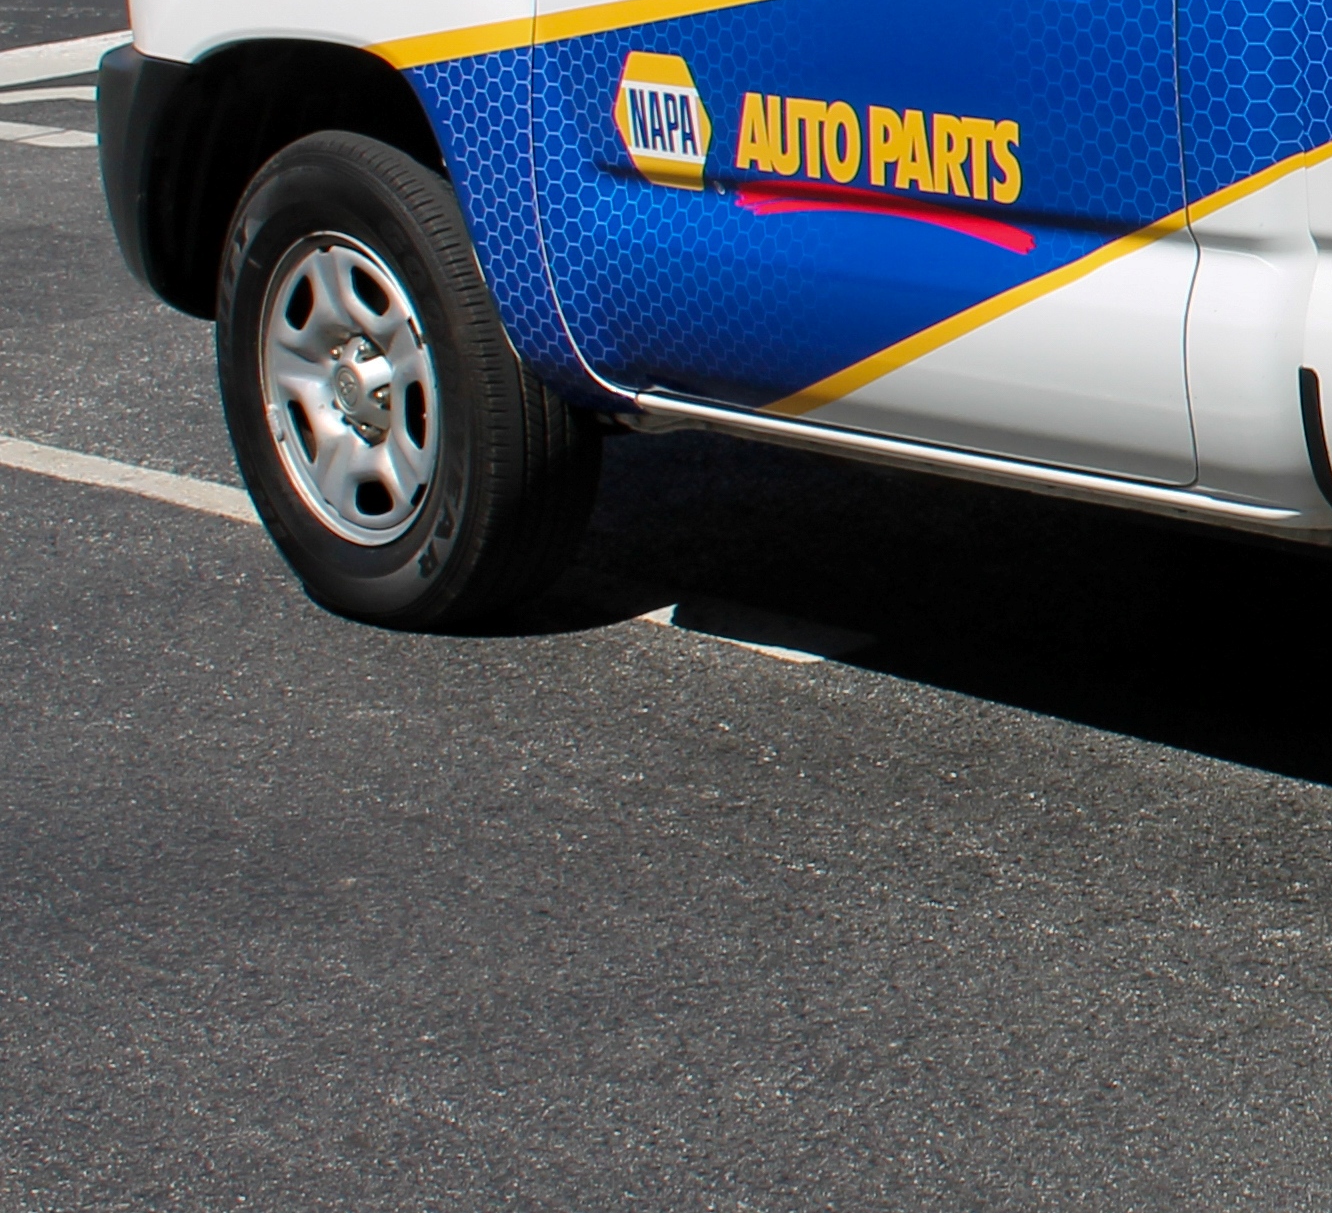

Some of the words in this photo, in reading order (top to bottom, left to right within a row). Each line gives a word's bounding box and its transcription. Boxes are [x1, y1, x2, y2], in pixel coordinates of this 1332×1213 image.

[627, 87, 699, 156] NAPA
[735, 92, 862, 184] AUTO
[867, 104, 1023, 205] PARTS
